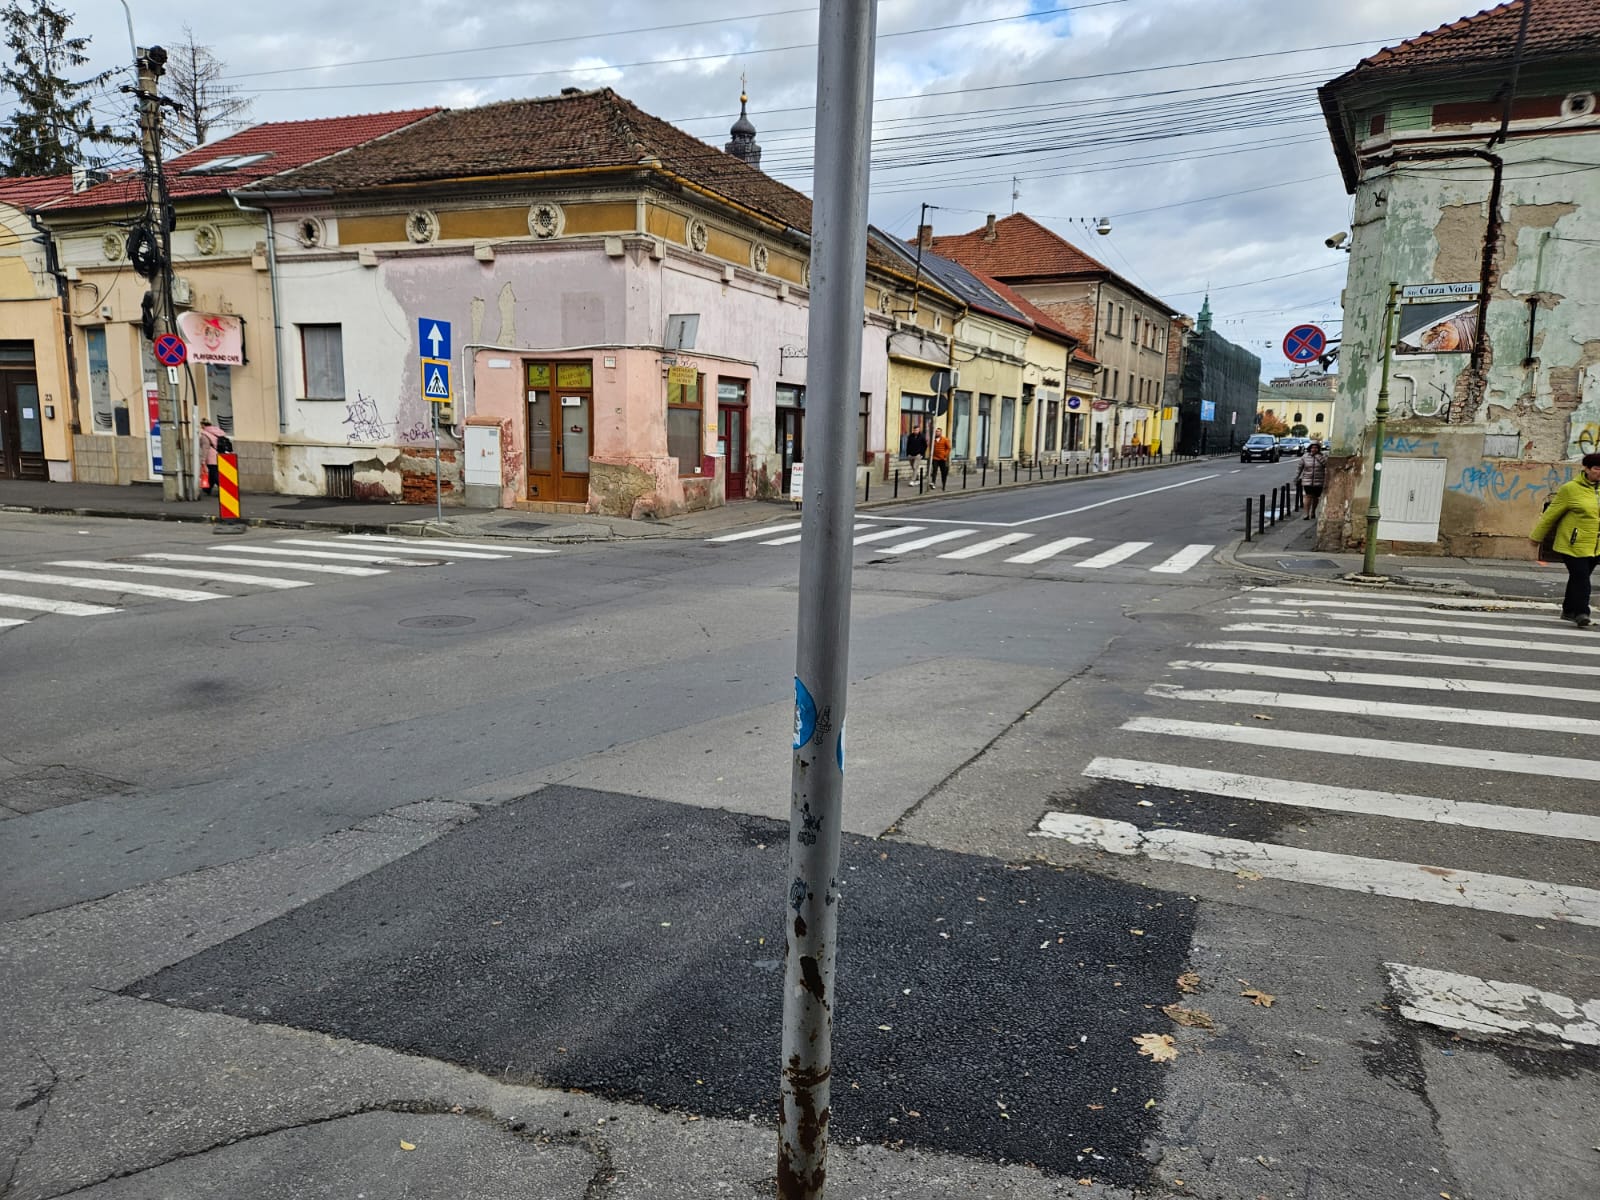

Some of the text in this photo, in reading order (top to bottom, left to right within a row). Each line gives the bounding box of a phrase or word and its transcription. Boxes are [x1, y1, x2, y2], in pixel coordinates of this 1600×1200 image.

[1420, 286, 1445, 295] Cuza
[1448, 284, 1473, 293] Vodă
[193, 353, 226, 361] PLAYGROUND
